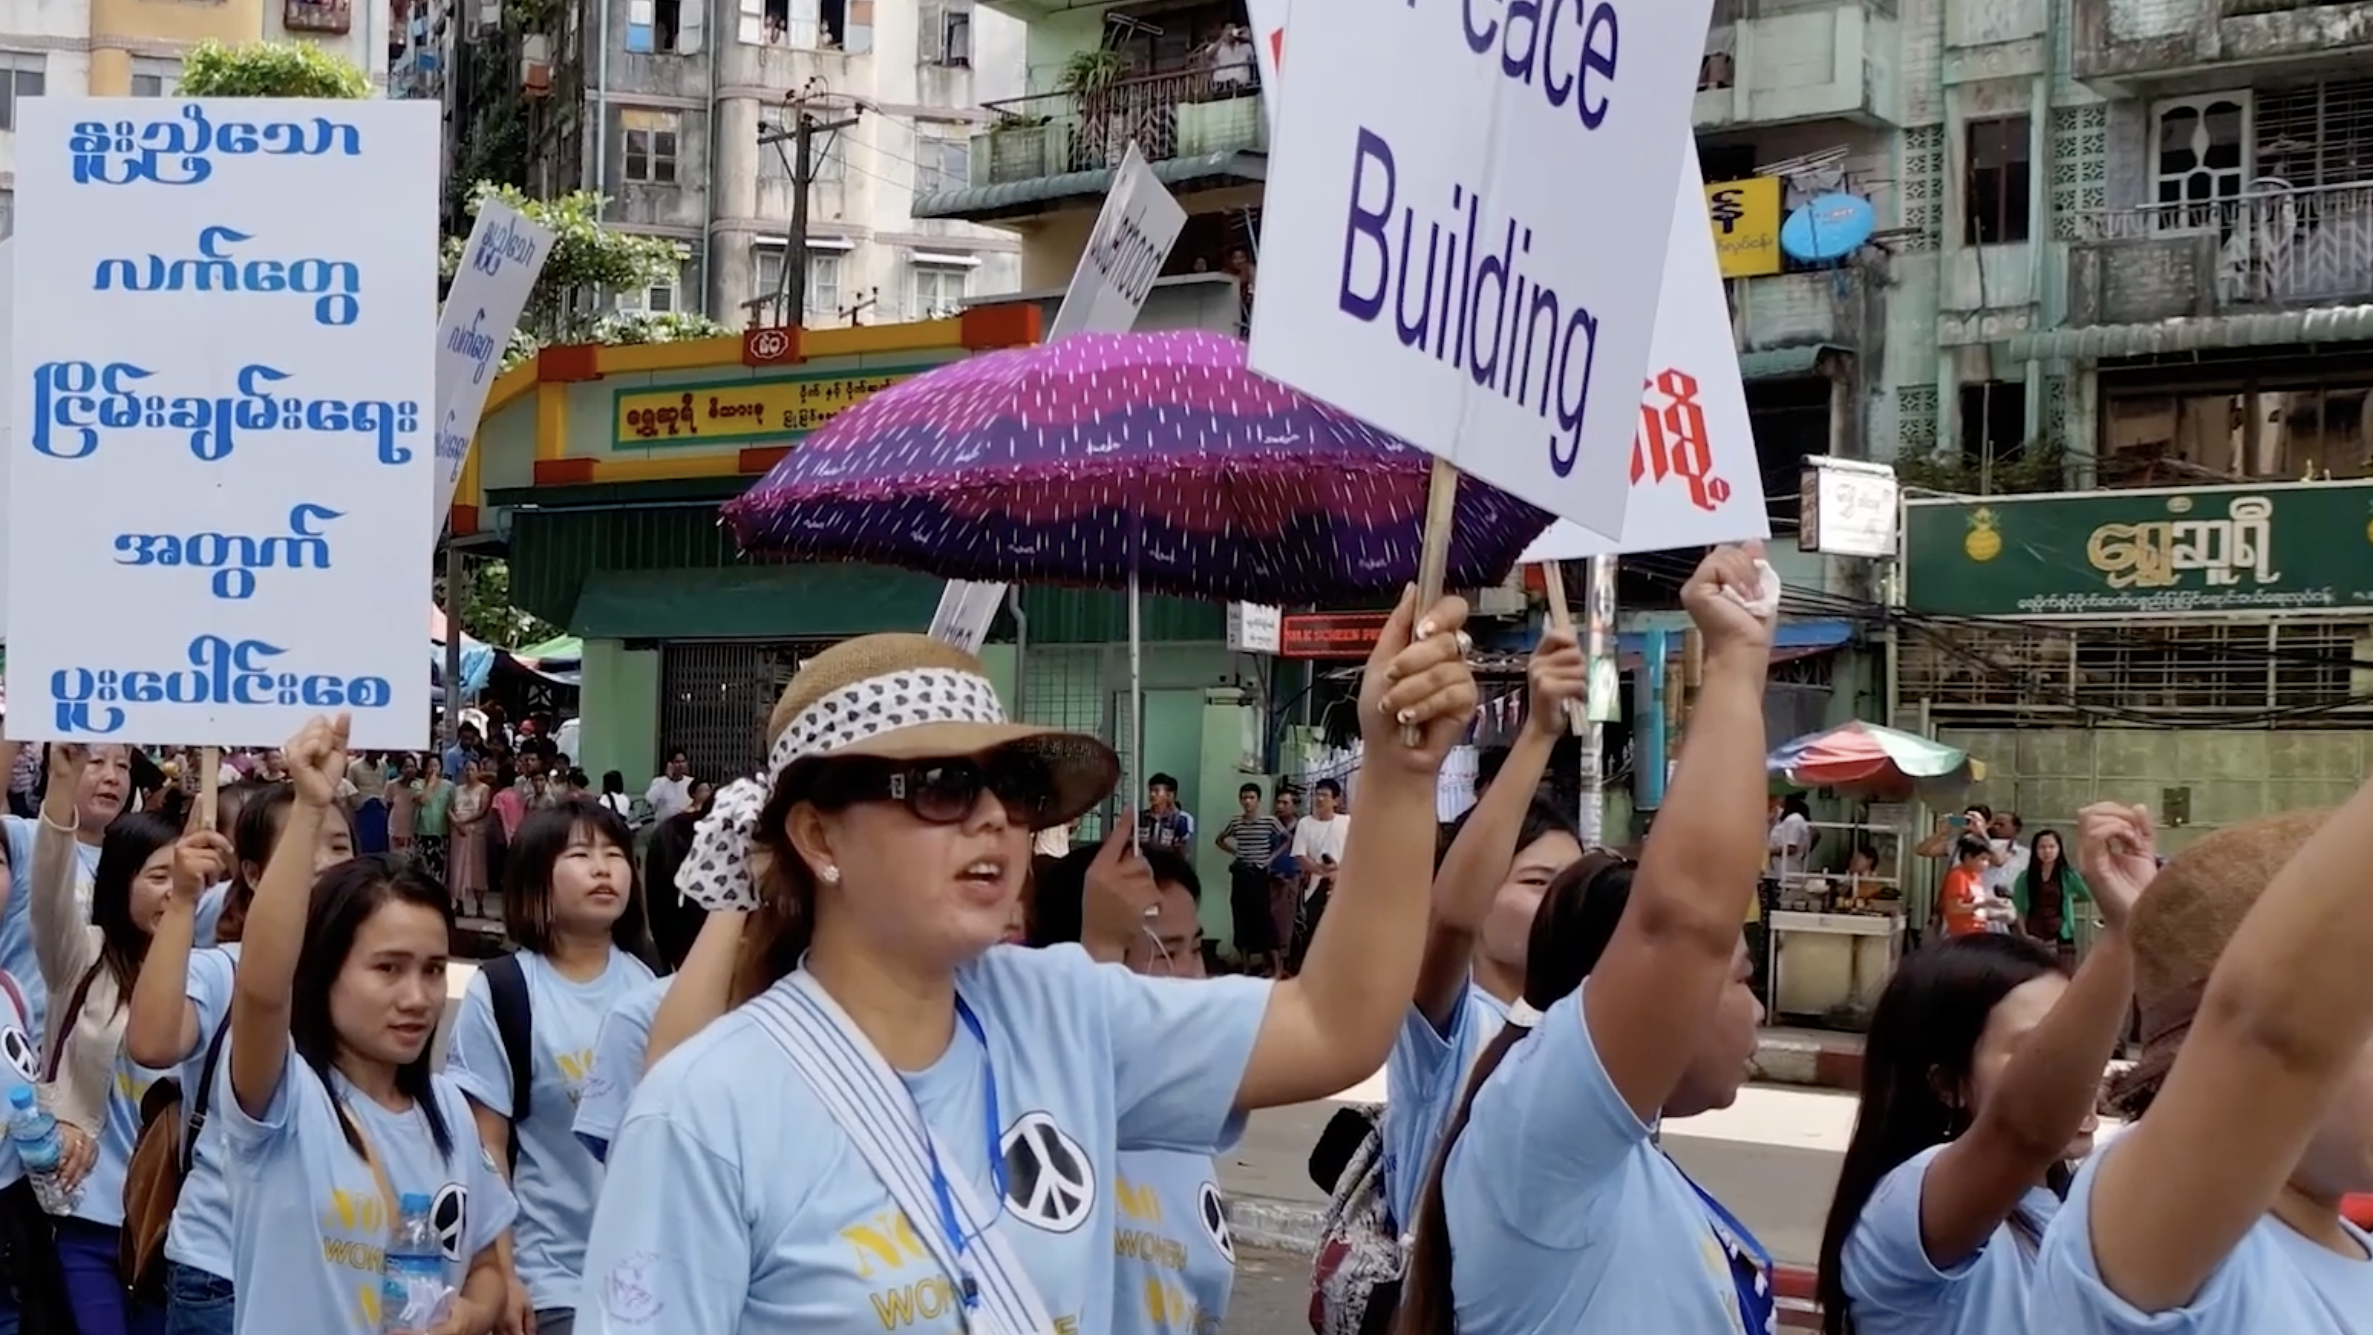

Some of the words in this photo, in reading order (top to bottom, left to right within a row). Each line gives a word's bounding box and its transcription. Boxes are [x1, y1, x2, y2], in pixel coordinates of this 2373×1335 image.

[1407, 0, 1619, 131] ace
[93, 225, 361, 326] လက်တွေ
[1340, 126, 1599, 478] Building
[32, 361, 418, 464] ငြိမ်းချမ်းရေး
[113, 503, 347, 599] အတွက်
[51, 634, 391, 733] ပူးပေါင်းစေ
[323, 1237, 387, 1276] WOM
